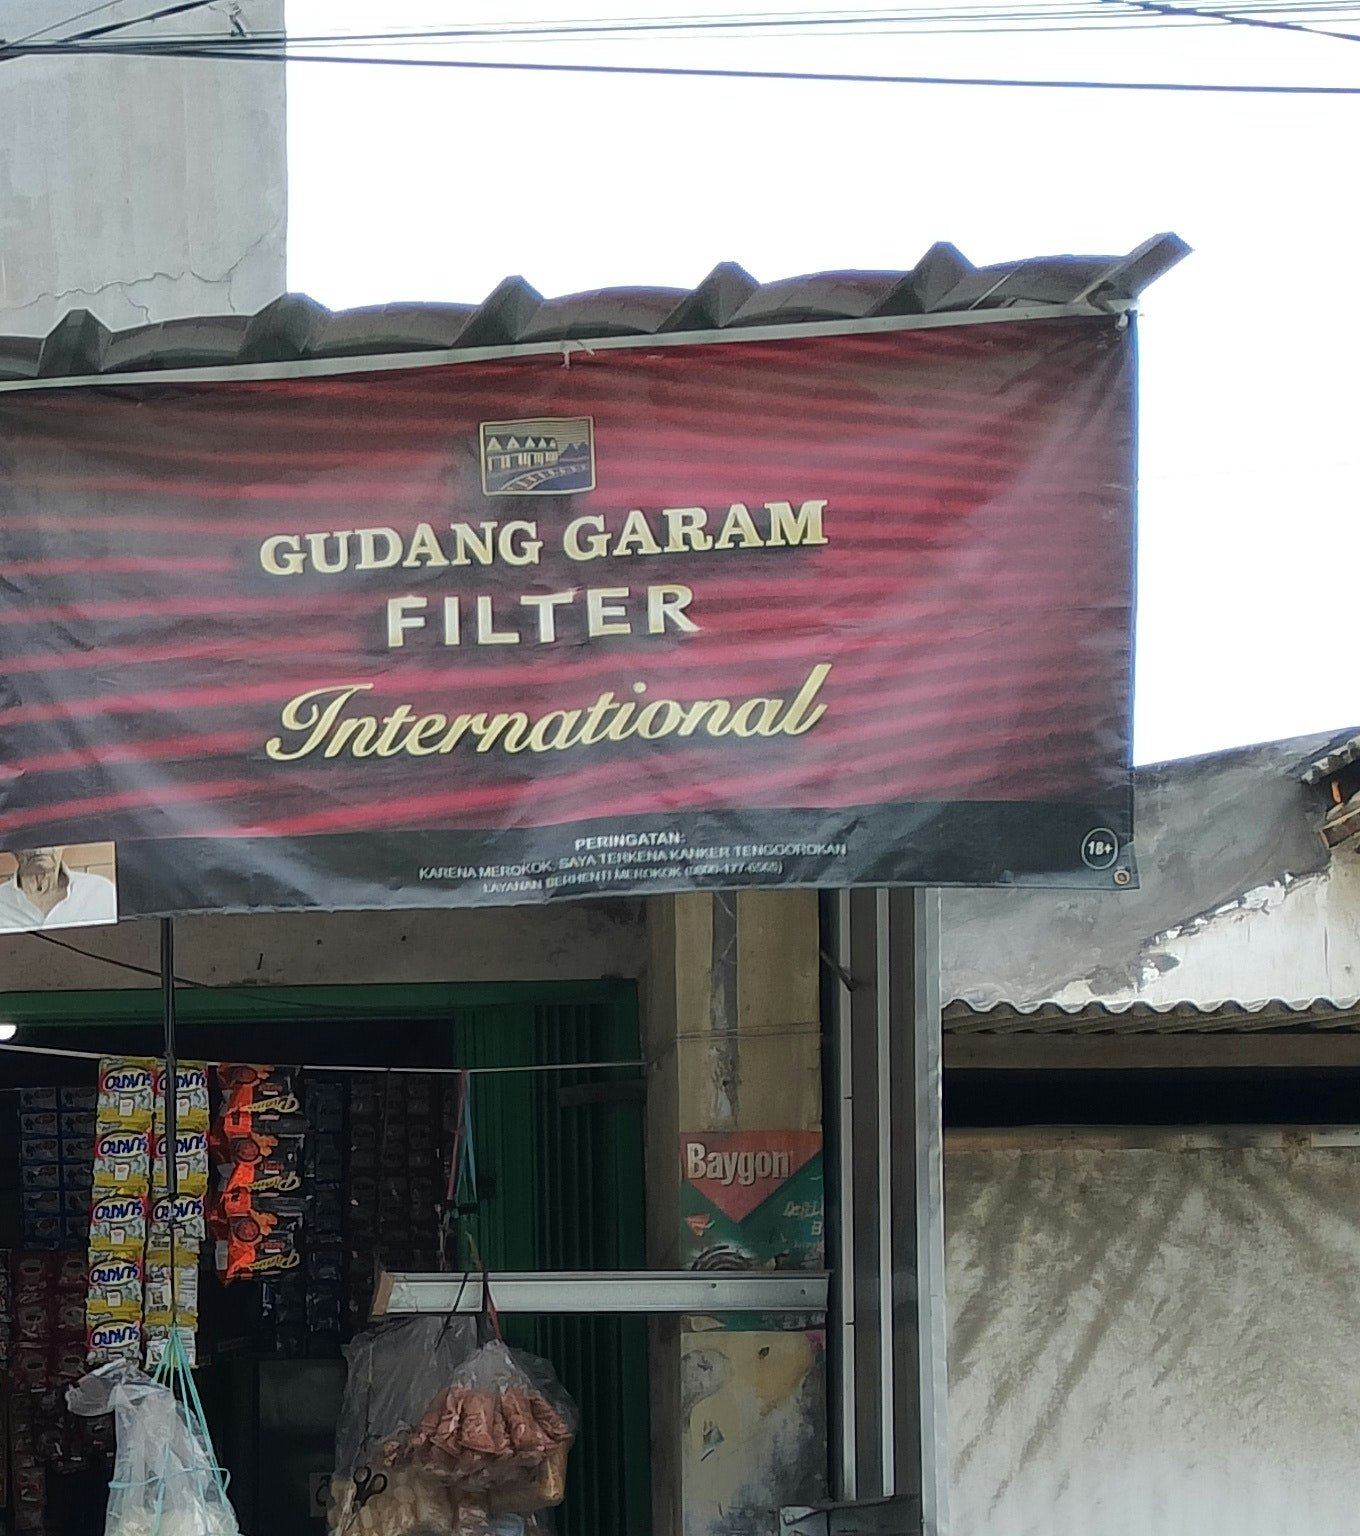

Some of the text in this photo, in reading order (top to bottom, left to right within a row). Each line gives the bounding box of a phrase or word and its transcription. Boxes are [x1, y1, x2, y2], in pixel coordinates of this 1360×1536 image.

[259, 500, 829, 576] GUDANG GARAM
[387, 583, 702, 651] FILTER
[265, 663, 834, 763] International
[574, 831, 686, 851] PERINGATAN:
[1087, 840, 1113, 857] 18+
[419, 866, 478, 881] KARENA
[558, 855, 598, 870] SAYA
[599, 849, 668, 866] TERKENA
[669, 845, 731, 861] KANKER
[483, 879, 543, 893] LAYANAN
[104, 1073, 152, 1090] SUKRO
[159, 1072, 206, 1090] SUKO
[100, 1134, 147, 1155] SUKRO
[158, 1134, 207, 1154] SUKO
[686, 1142, 790, 1187] Baygon
[94, 1200, 143, 1220] SUKRO
[91, 1264, 139, 1284] SUKRO
[93, 1326, 140, 1345] SUKRO
